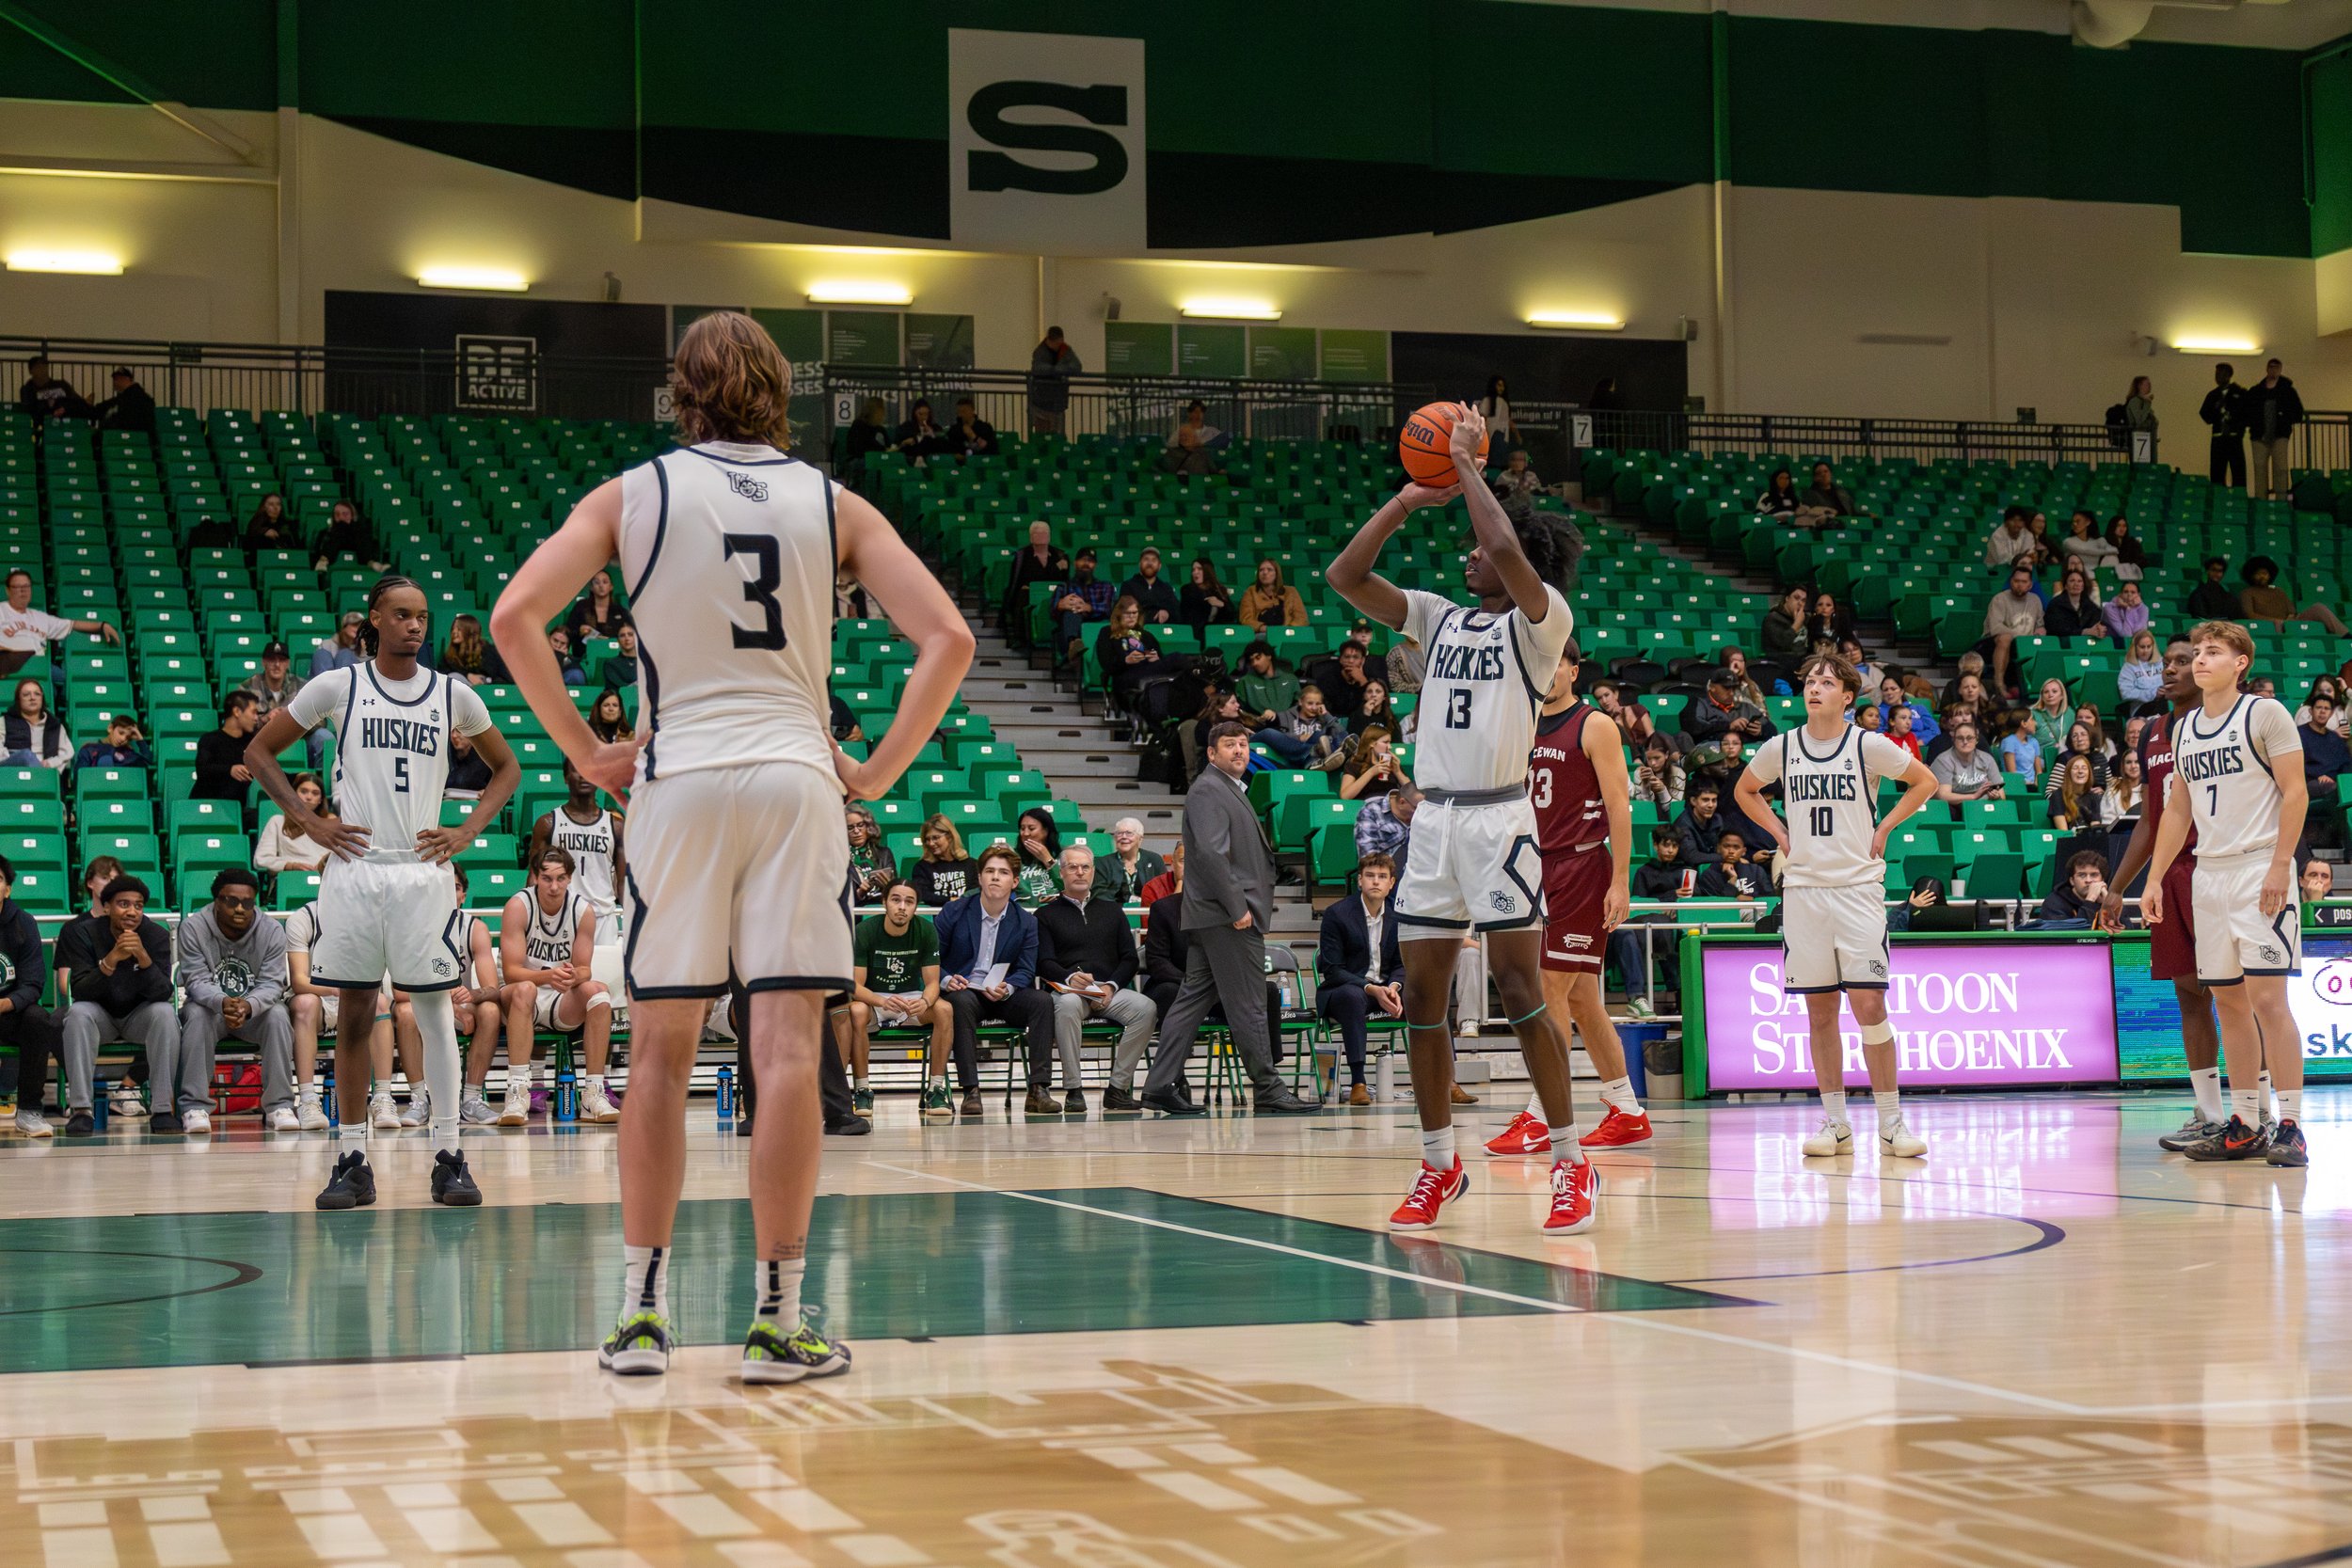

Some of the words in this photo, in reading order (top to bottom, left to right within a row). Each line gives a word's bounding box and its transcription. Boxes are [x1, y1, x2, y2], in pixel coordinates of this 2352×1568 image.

[967, 80, 1127, 195] S
[469, 385, 527, 400] ACTIVE
[839, 401, 850, 420] 8
[1578, 421, 1588, 442] 7
[2137, 438, 2147, 457] 7
[723, 532, 787, 651] 3
[1445, 688, 1472, 730] 13
[361, 718, 440, 757] HUSKIES
[1533, 746, 1565, 762] CEWAN
[2182, 745, 2244, 784] HUSKIES
[395, 757, 409, 792] 5
[1788, 774, 1856, 803] HUSKIES
[2206, 784, 2217, 816] 7
[1809, 806, 1833, 836] 10
[558, 832, 610, 854] HUSKIES
[580, 856, 585, 877] 1
[933, 871, 966, 883] POWER
[526, 937, 571, 962] HUSKIES
[721, 1078, 729, 1110] POWERADE
